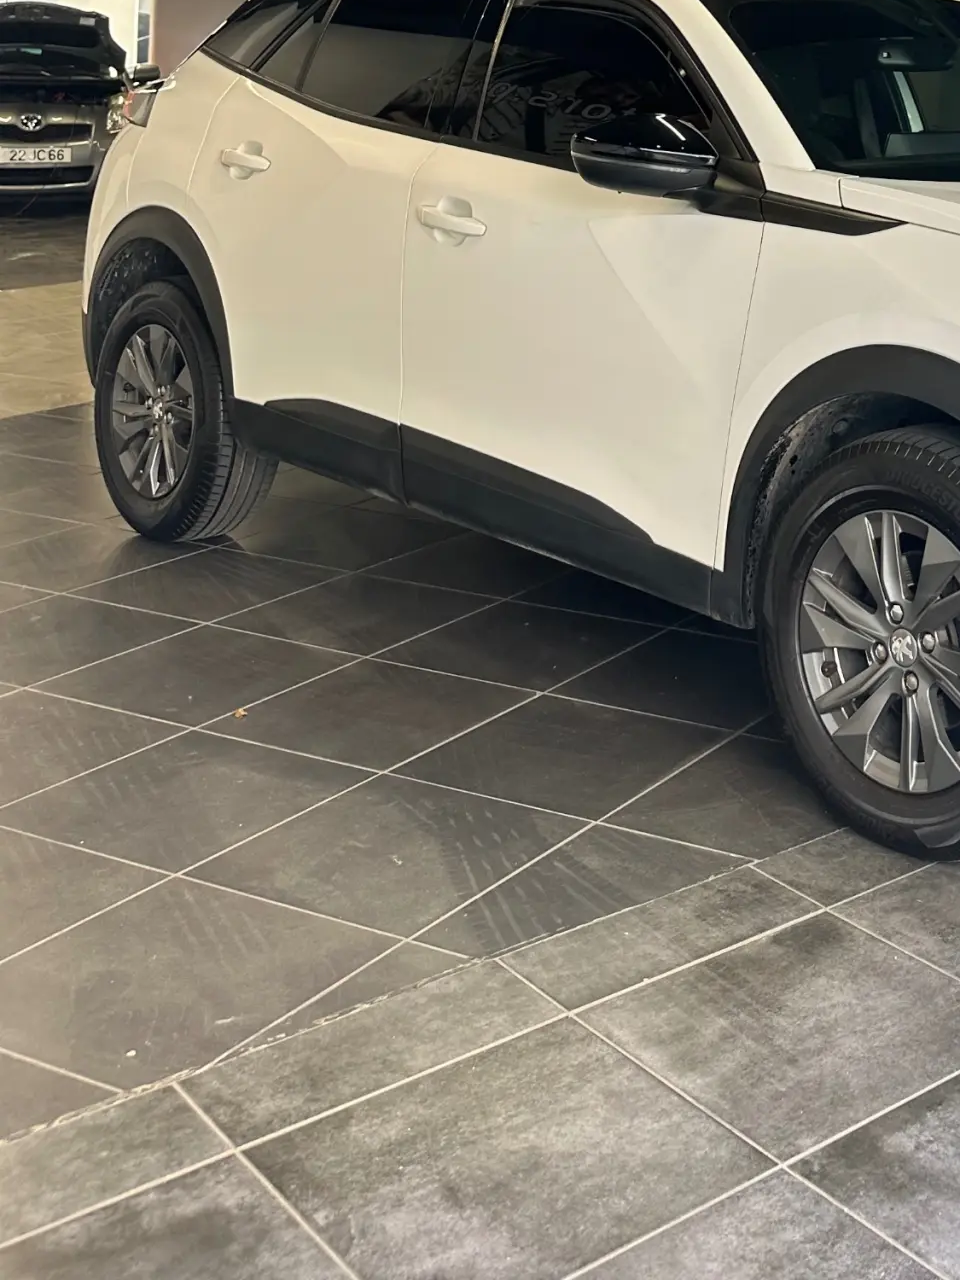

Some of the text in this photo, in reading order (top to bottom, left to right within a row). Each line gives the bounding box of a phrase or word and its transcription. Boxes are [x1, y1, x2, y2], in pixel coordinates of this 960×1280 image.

[9, 149, 65, 161] 22 JC 66
